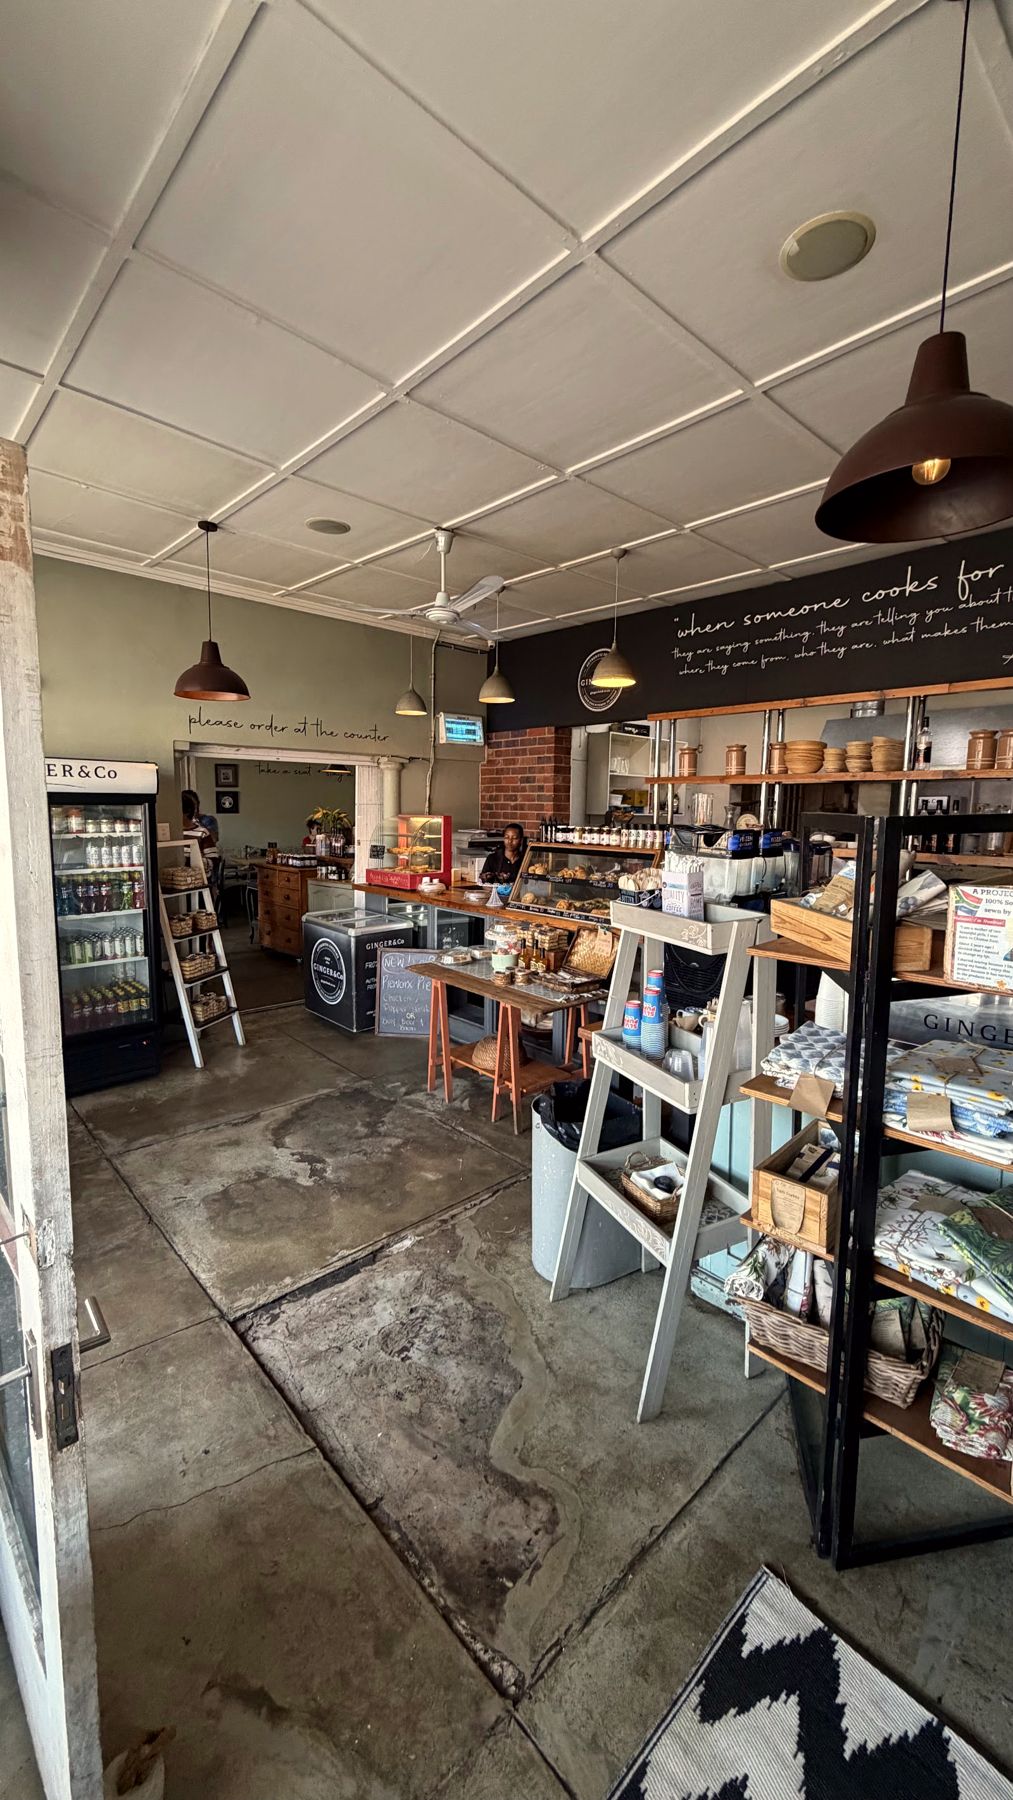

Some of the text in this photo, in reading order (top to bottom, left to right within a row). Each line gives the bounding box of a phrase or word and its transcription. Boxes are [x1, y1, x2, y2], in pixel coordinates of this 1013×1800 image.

[743, 598, 850, 626] someone
[862, 566, 939, 602] cooks
[957, 560, 1005, 601] for
[671, 647, 694, 662] they
[716, 641, 751, 655] saying
[816, 620, 848, 638] they
[851, 620, 873, 628] are
[873, 607, 920, 626] telling
[925, 606, 954, 623] you
[958, 587, 1002, 609] about
[679, 664, 705, 675] where
[705, 660, 730, 676] they
[794, 646, 817, 658] who
[816, 641, 848, 659] they
[883, 627, 916, 645] what
[921, 622, 968, 639] makes
[969, 616, 1013, 633] them
[188, 706, 389, 742] please order at the counter
[365, 938, 405, 951] GINGER&Co
[313, 962, 344, 981] GINGER&Co
[406, 1012, 416, 1020] OR
